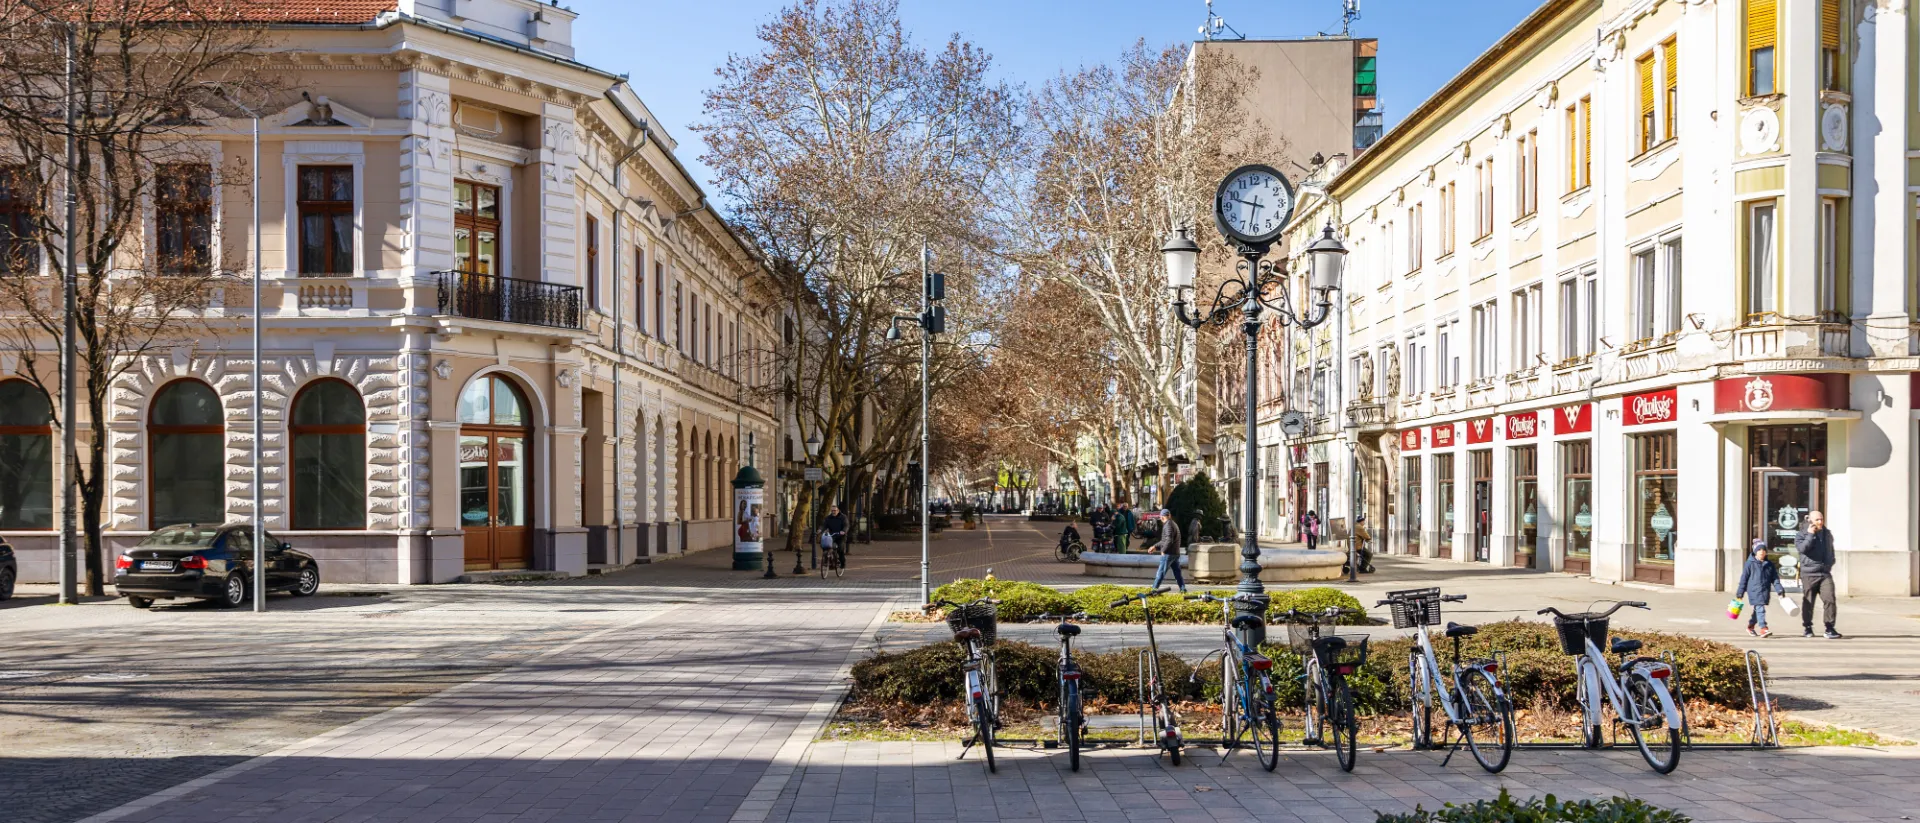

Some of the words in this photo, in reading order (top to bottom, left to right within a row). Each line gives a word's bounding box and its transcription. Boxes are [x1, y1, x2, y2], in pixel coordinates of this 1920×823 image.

[1239, 180, 1247, 189] 11
[1249, 176, 1260, 185] 12
[1264, 179, 1269, 188] 1
[1230, 191, 1239, 200] 10
[1273, 187, 1279, 196] 2
[1226, 202, 1232, 211] 9
[1278, 199, 1284, 208] 3
[1231, 213, 1237, 222] 8
[1274, 211, 1279, 220] 4
[1240, 221, 1246, 229] 7
[1266, 219, 1272, 228] 5
[1253, 224, 1259, 233] 6
